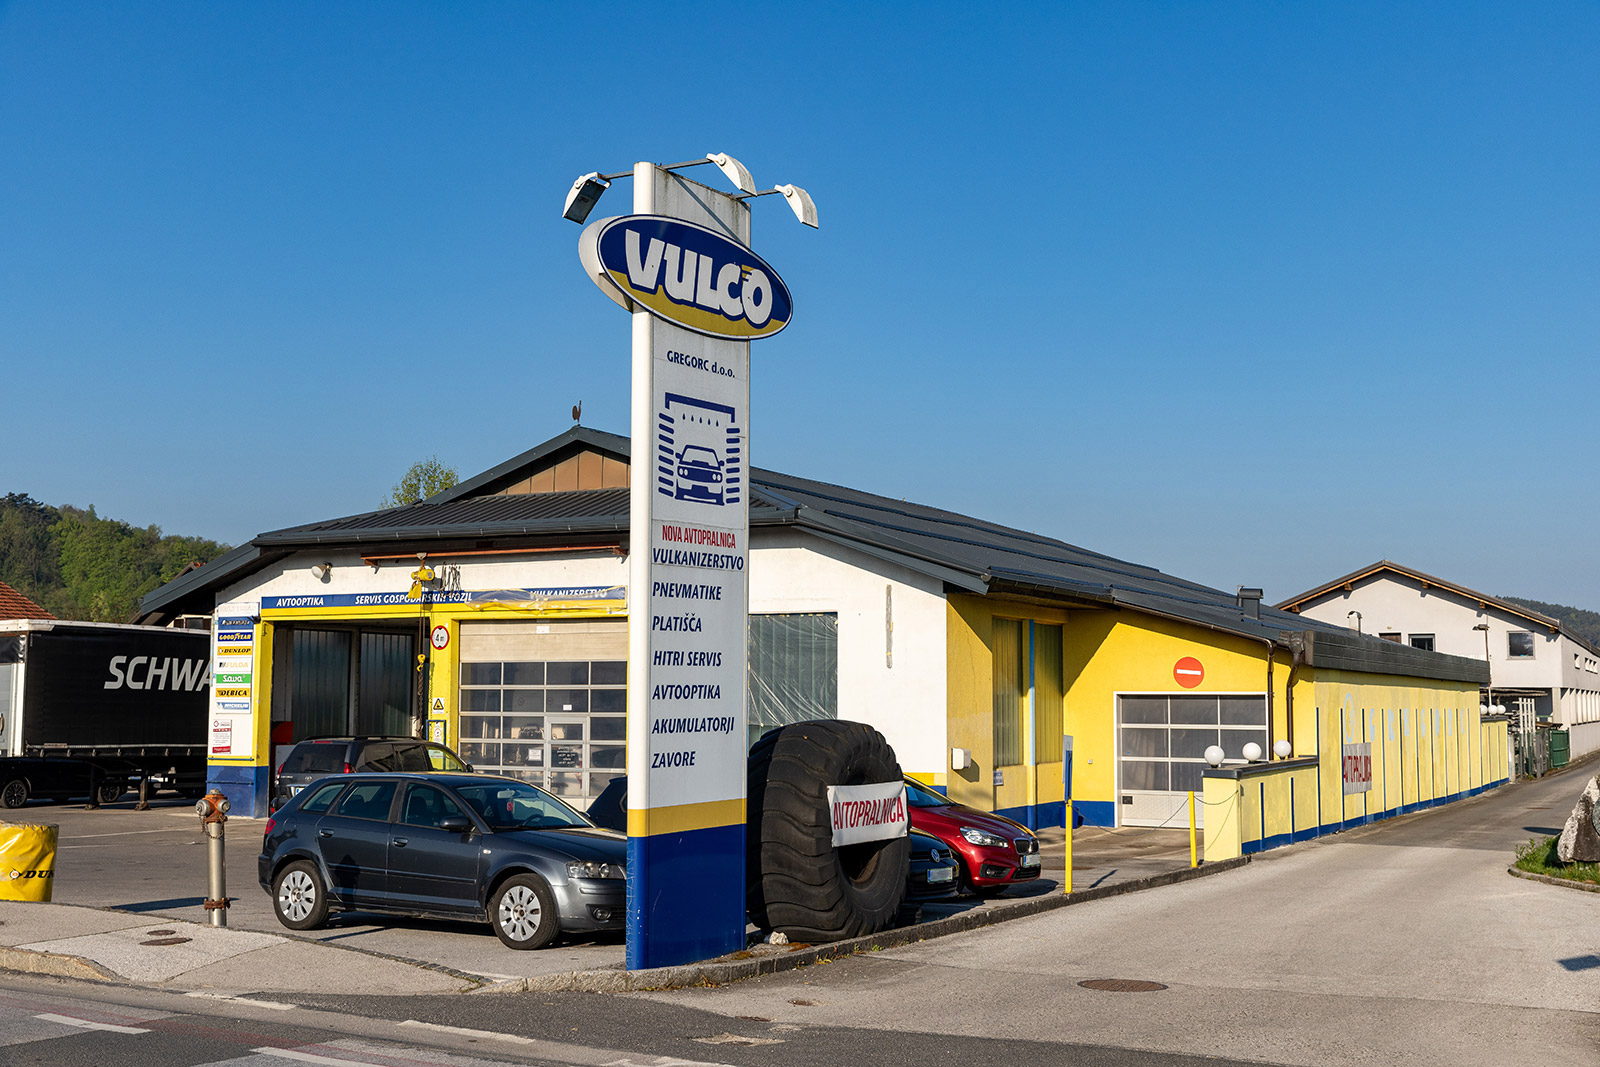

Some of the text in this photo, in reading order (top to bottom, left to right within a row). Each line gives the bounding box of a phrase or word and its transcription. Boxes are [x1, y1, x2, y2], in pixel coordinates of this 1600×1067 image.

[625, 228, 773, 325] VULCO
[666, 350, 736, 379] GREGORC d.o.o.
[662, 524, 736, 549] NOVA AVTOPRALNICA
[652, 547, 744, 571] VULKANIZERSTVO
[276, 596, 324, 607] AVTOOPTIKA
[355, 594, 382, 605] SERVIS
[652, 581, 722, 601] PNEVMATIKE
[652, 612, 702, 632] PLATIŠČA
[653, 650, 722, 667] HITRI SERVIS
[652, 684, 721, 700] AVTOOPTIKA
[651, 716, 735, 735] AKUMULATORJI
[651, 751, 696, 769] ZAVORE
[833, 796, 905, 830] AVTOPRALNICA
